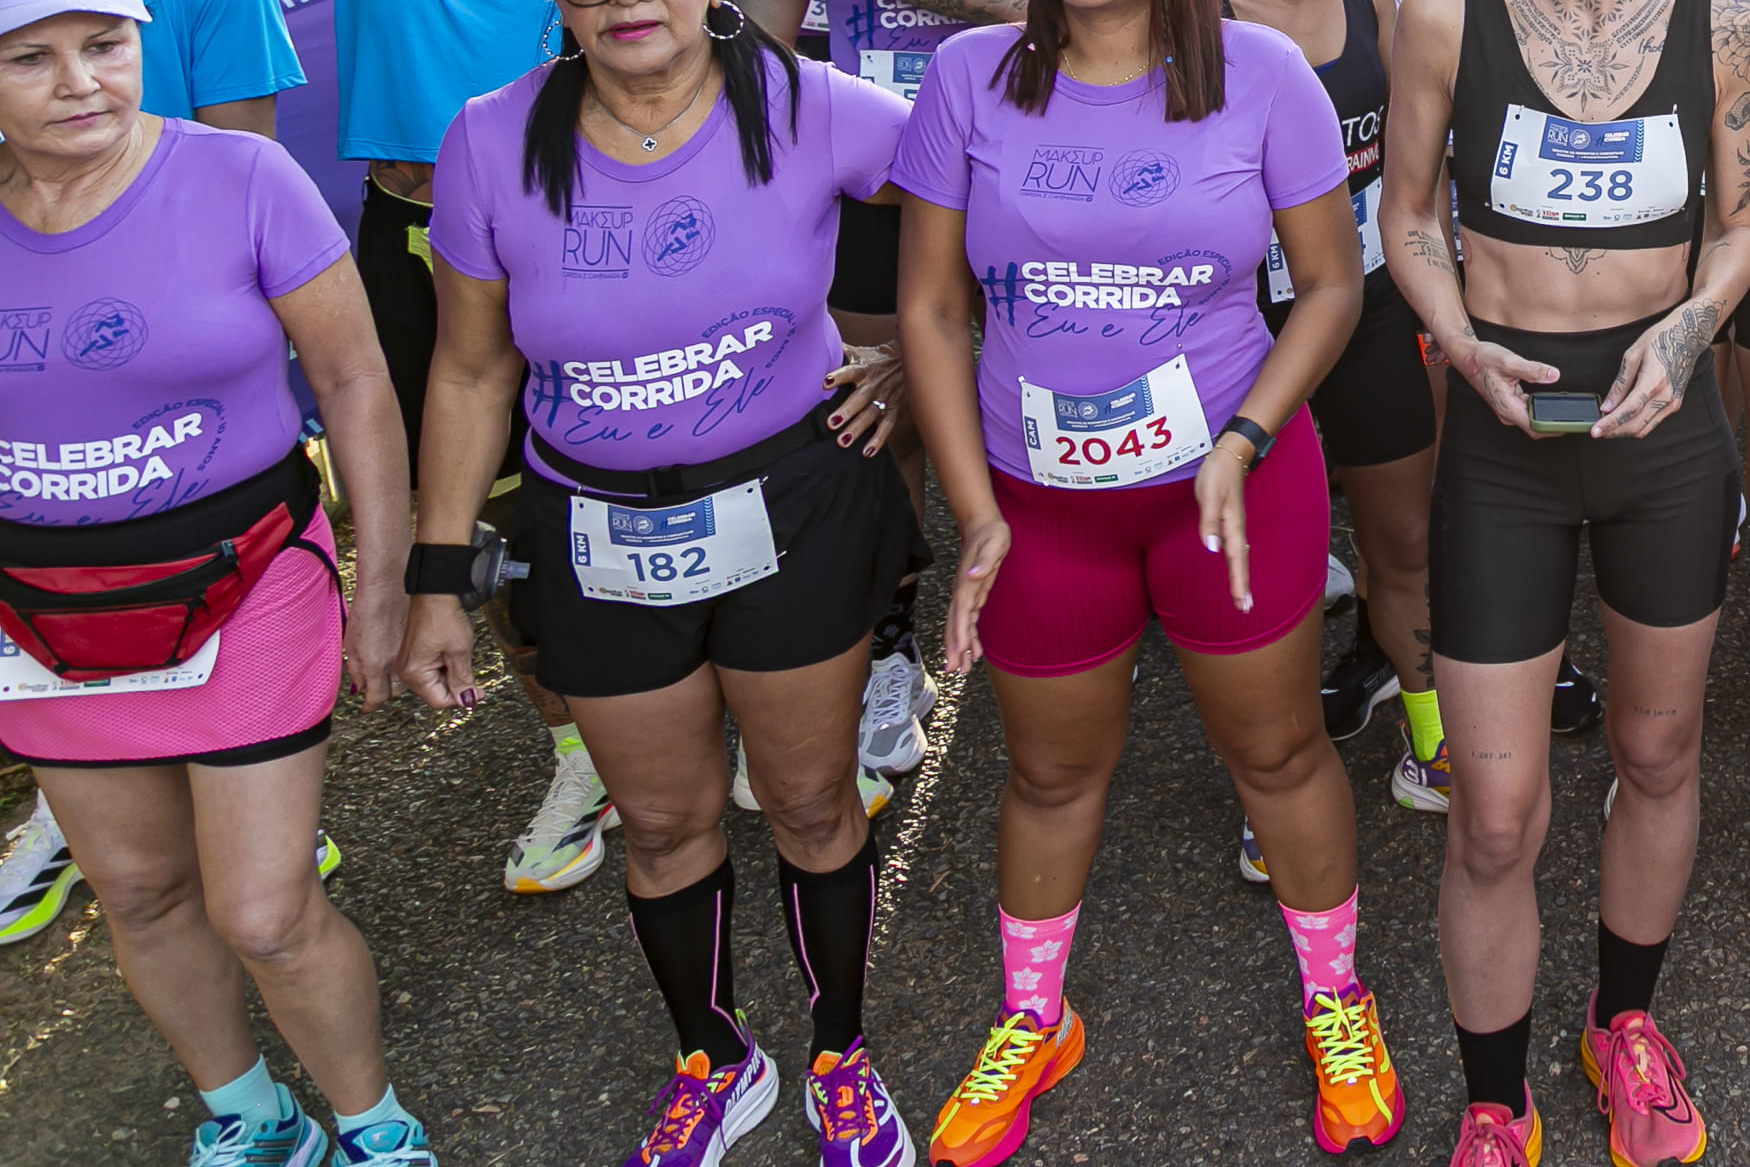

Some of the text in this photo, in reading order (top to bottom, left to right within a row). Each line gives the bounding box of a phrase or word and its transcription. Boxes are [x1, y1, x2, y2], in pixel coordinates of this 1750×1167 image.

[1548, 129, 1568, 143] RUN
[1501, 144, 1514, 166] KM
[1022, 161, 1101, 193] RUN
[1500, 167, 1509, 176] 6
[1547, 169, 1633, 202] 238
[562, 227, 633, 266] RUN
[1158, 249, 1201, 266] EDIÇÃO
[1271, 245, 1280, 262] KM
[1021, 261, 1214, 287] CELEBRAR
[1023, 284, 1182, 309] CORRIDA
[702, 310, 749, 339] EDIÇÃO
[1026, 300, 1206, 346] Eu e Ele
[563, 321, 774, 383] CELEBRAR
[569, 359, 744, 411] CORRIDA
[564, 367, 774, 445] Eu e Ele
[1027, 420, 1038, 447] CAM
[1056, 415, 1172, 466] 2043
[612, 517, 633, 531] RUN
[577, 535, 587, 553] KM
[578, 554, 588, 564] 6
[627, 547, 711, 582] 182
